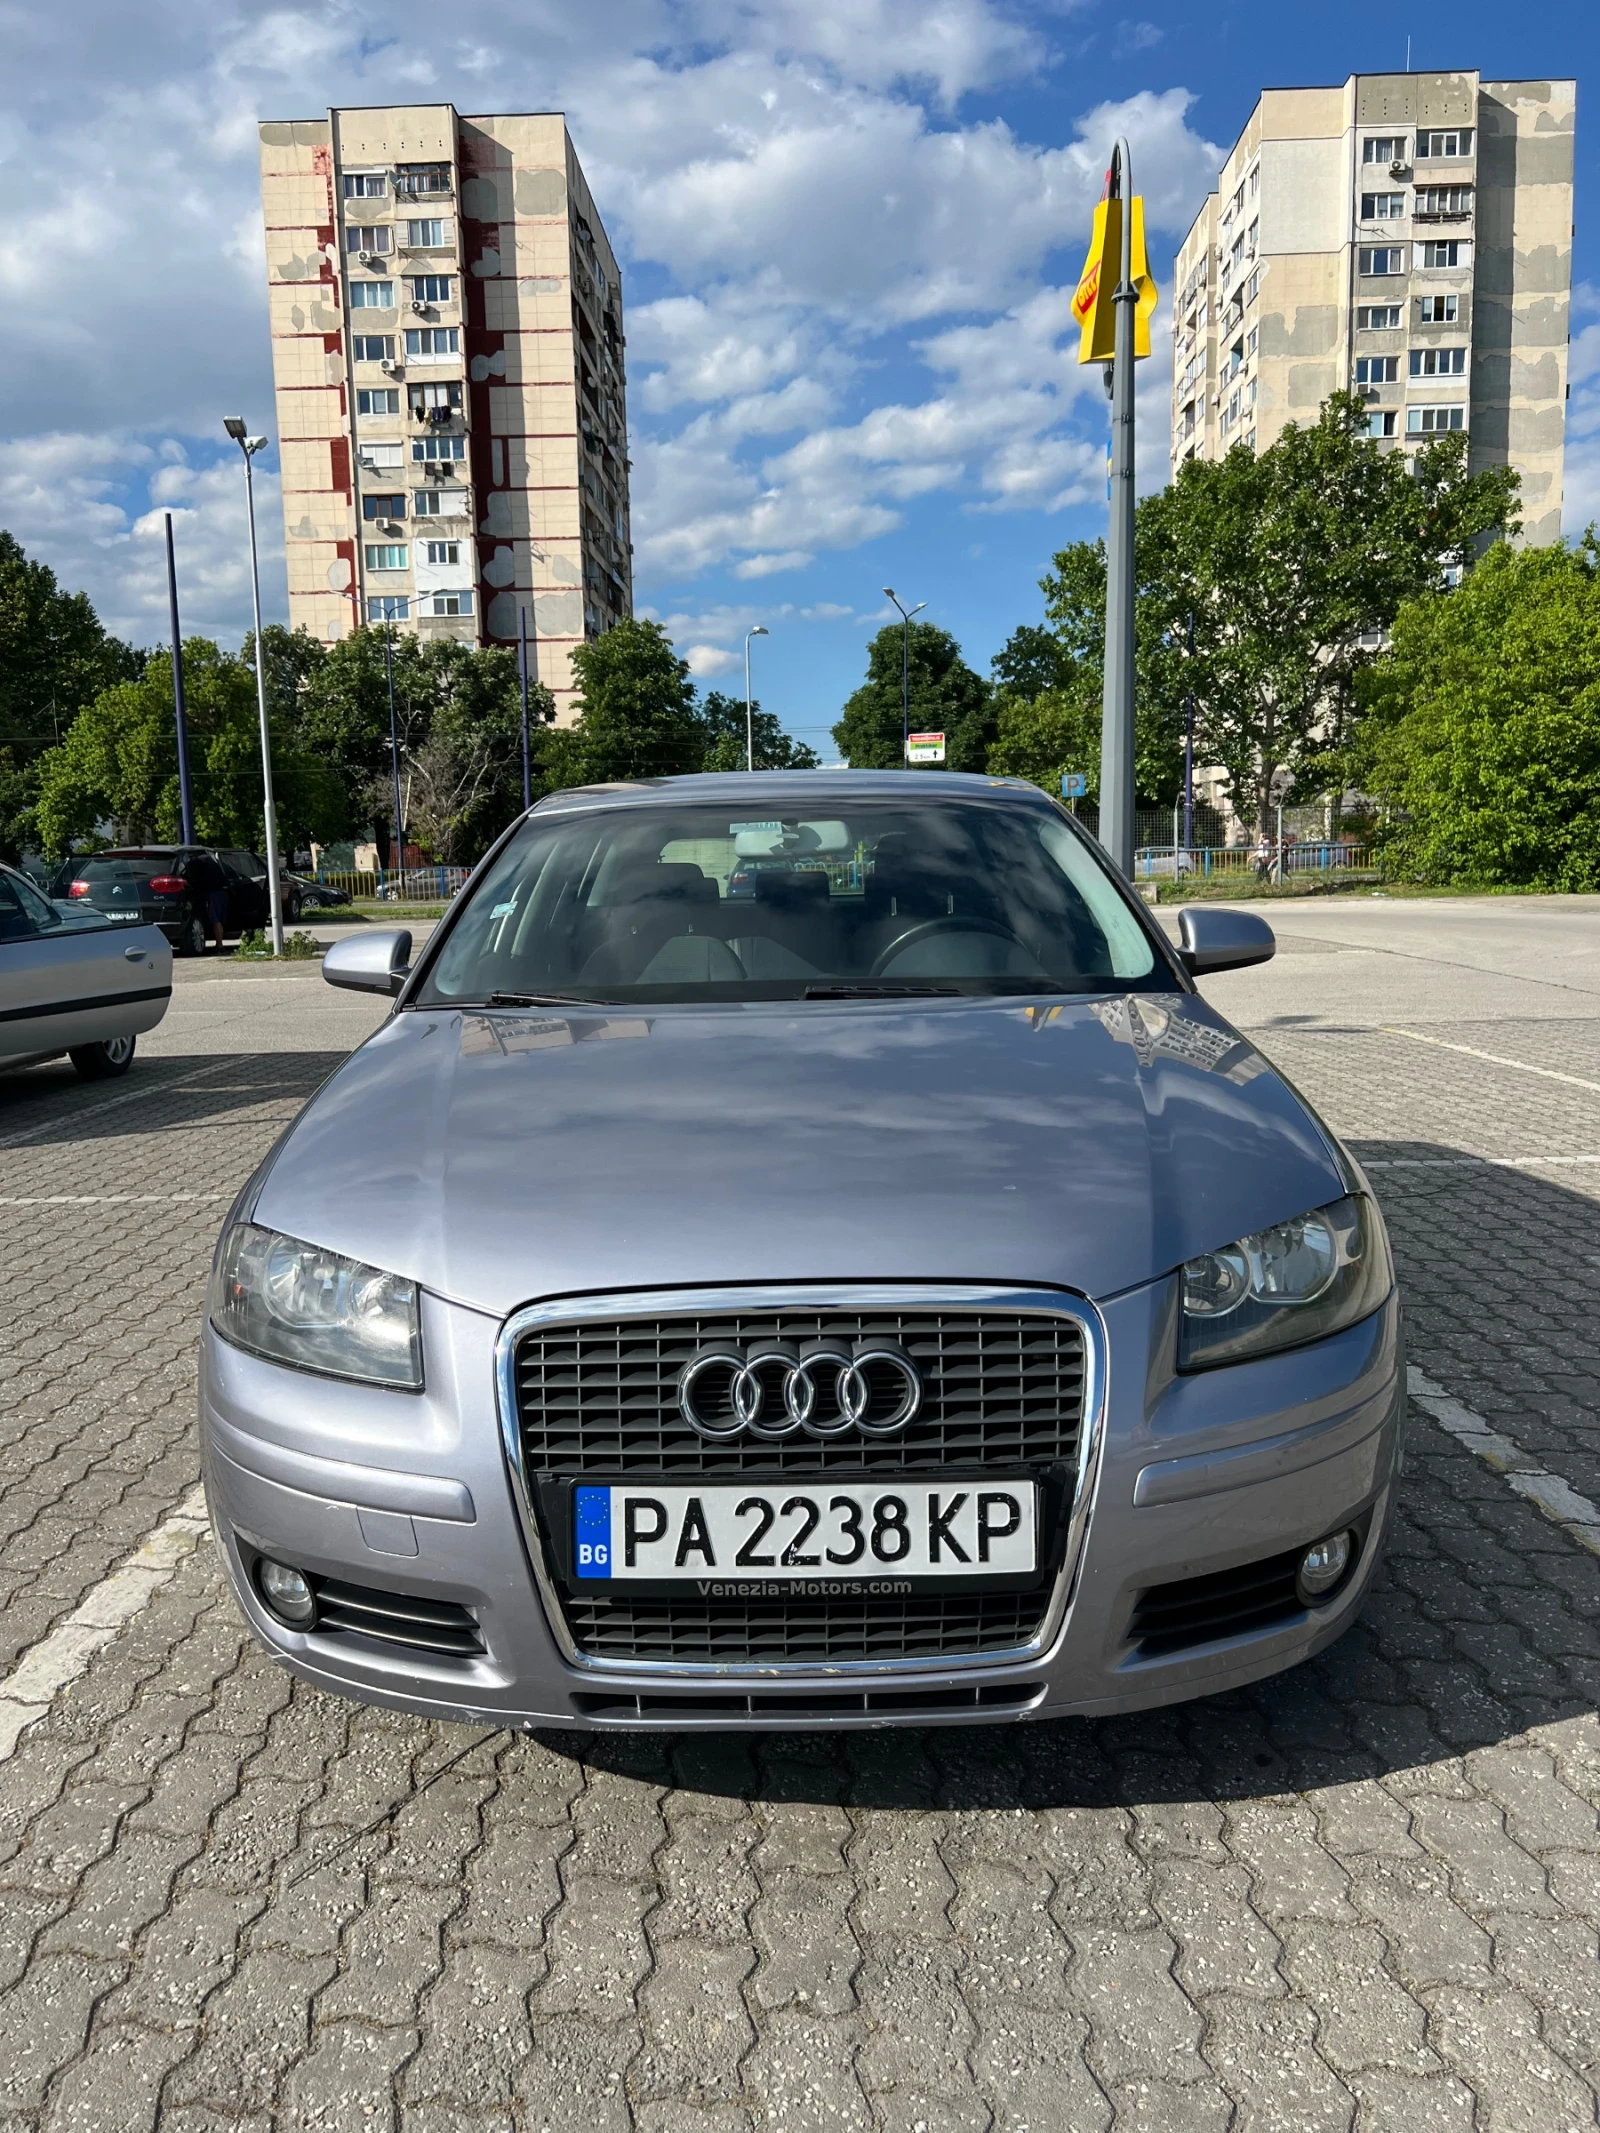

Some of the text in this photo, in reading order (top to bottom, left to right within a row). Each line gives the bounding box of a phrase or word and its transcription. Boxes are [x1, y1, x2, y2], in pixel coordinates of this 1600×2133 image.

[1067, 777, 1080, 796] P
[624, 1491, 1022, 1568] PA 2238 KP
[578, 1544, 608, 1566] BG
[696, 1579, 912, 1597] Venezia-Motors.com
